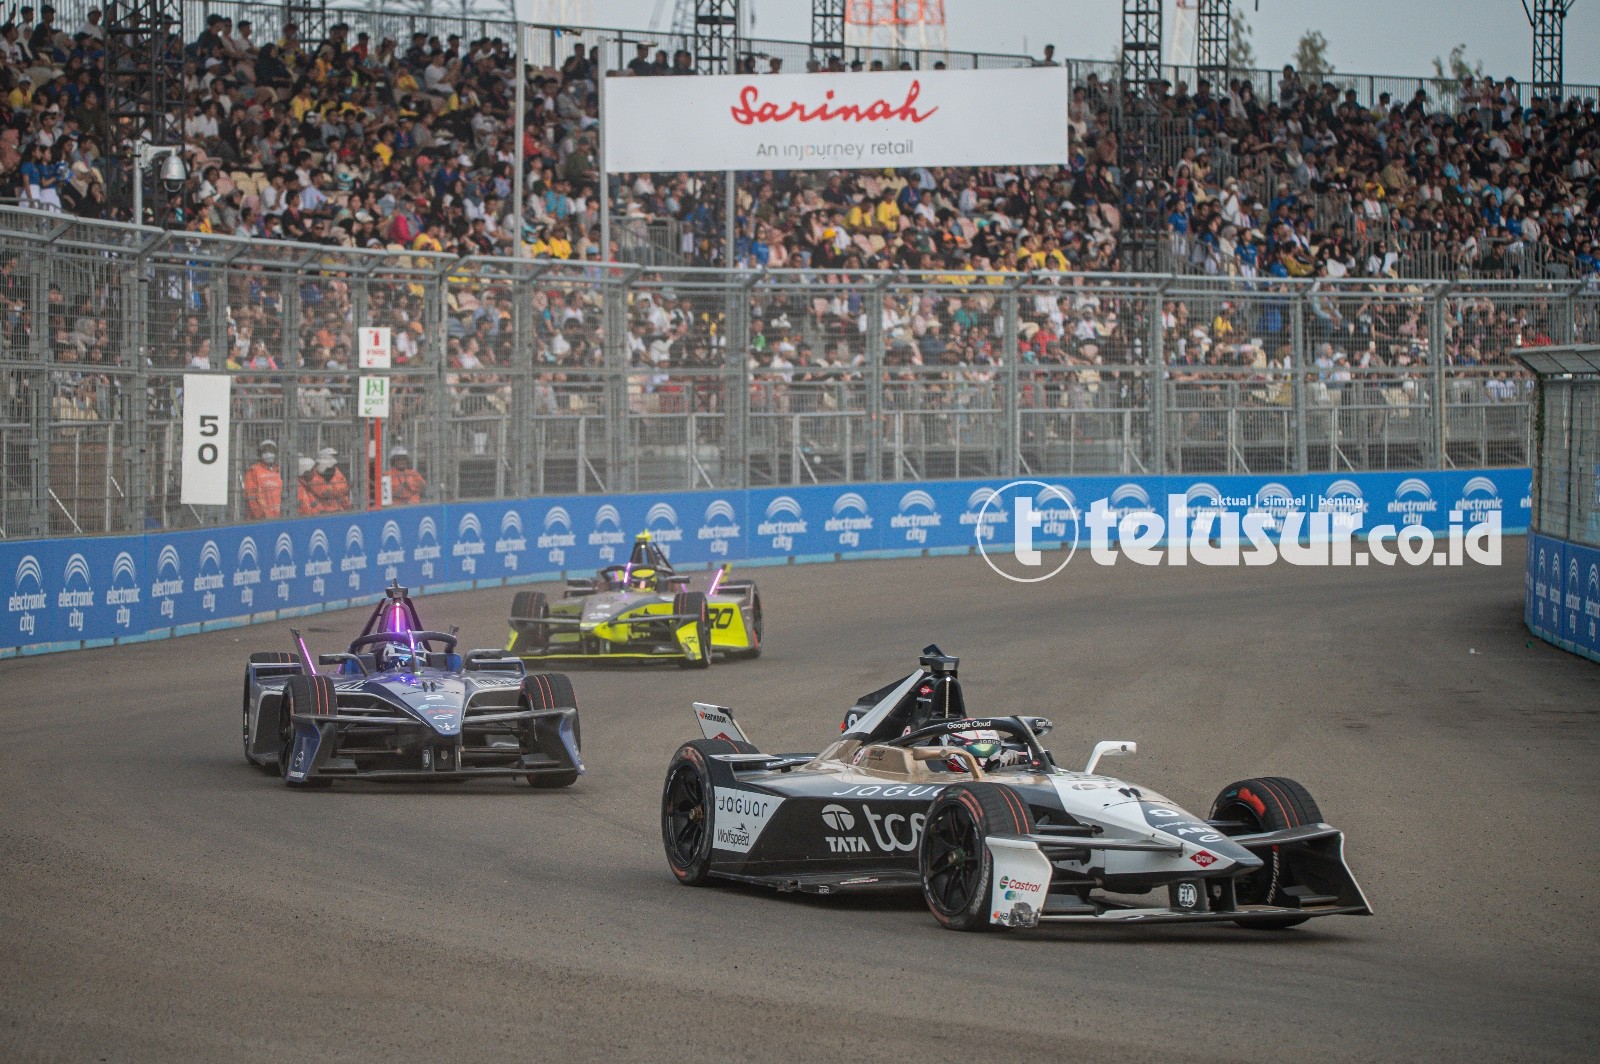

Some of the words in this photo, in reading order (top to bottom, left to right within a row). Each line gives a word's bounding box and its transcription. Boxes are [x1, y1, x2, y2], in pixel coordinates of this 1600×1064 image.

[731, 79, 939, 125] Sarinah
[756, 142, 778, 157] An
[783, 140, 865, 161] injourney
[870, 139, 914, 155] retail
[1387, 498, 1437, 513] electronic
[1454, 495, 1503, 510] electronic
[824, 515, 874, 531] electronic
[890, 512, 942, 528] electronic
[959, 508, 1009, 525] electronic
[1402, 510, 1423, 526] city
[757, 518, 808, 535] electronic
[906, 527, 927, 543] city
[1043, 520, 1066, 537] city
[772, 534, 793, 551] city
[839, 530, 860, 547] city
[106, 584, 141, 605] electronic
[152, 576, 184, 597] electronic
[8, 589, 47, 611] electronic
[58, 587, 95, 607] electronic
[116, 605, 130, 628] city
[161, 597, 174, 619] city
[20, 610, 35, 635] city
[69, 608, 84, 631] city
[947, 721, 971, 730] Google
[971, 720, 992, 728] Cloud
[832, 785, 945, 797] JaGU
[717, 828, 750, 847] Wolfspeed
[825, 836, 871, 852] TATA
[1008, 879, 1041, 892] Castrol
